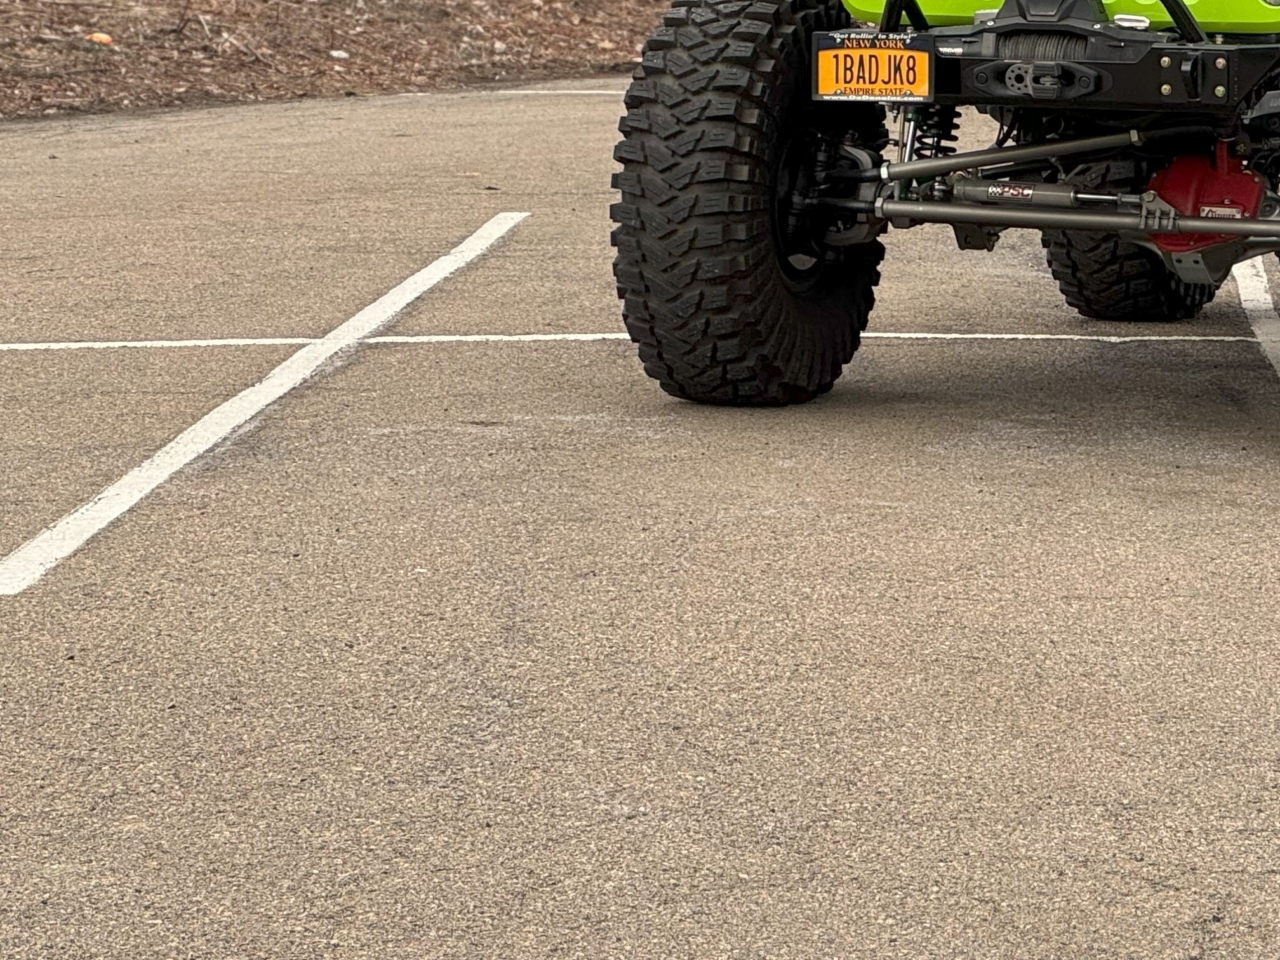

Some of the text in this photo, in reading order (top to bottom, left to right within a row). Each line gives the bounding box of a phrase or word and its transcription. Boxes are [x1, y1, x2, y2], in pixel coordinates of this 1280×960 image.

[843, 39, 905, 49] NEW YORK
[832, 54, 917, 86] 1BADJK8
[843, 86, 905, 96] EMPIRE STATE
[1000, 184, 1032, 197] PSC
